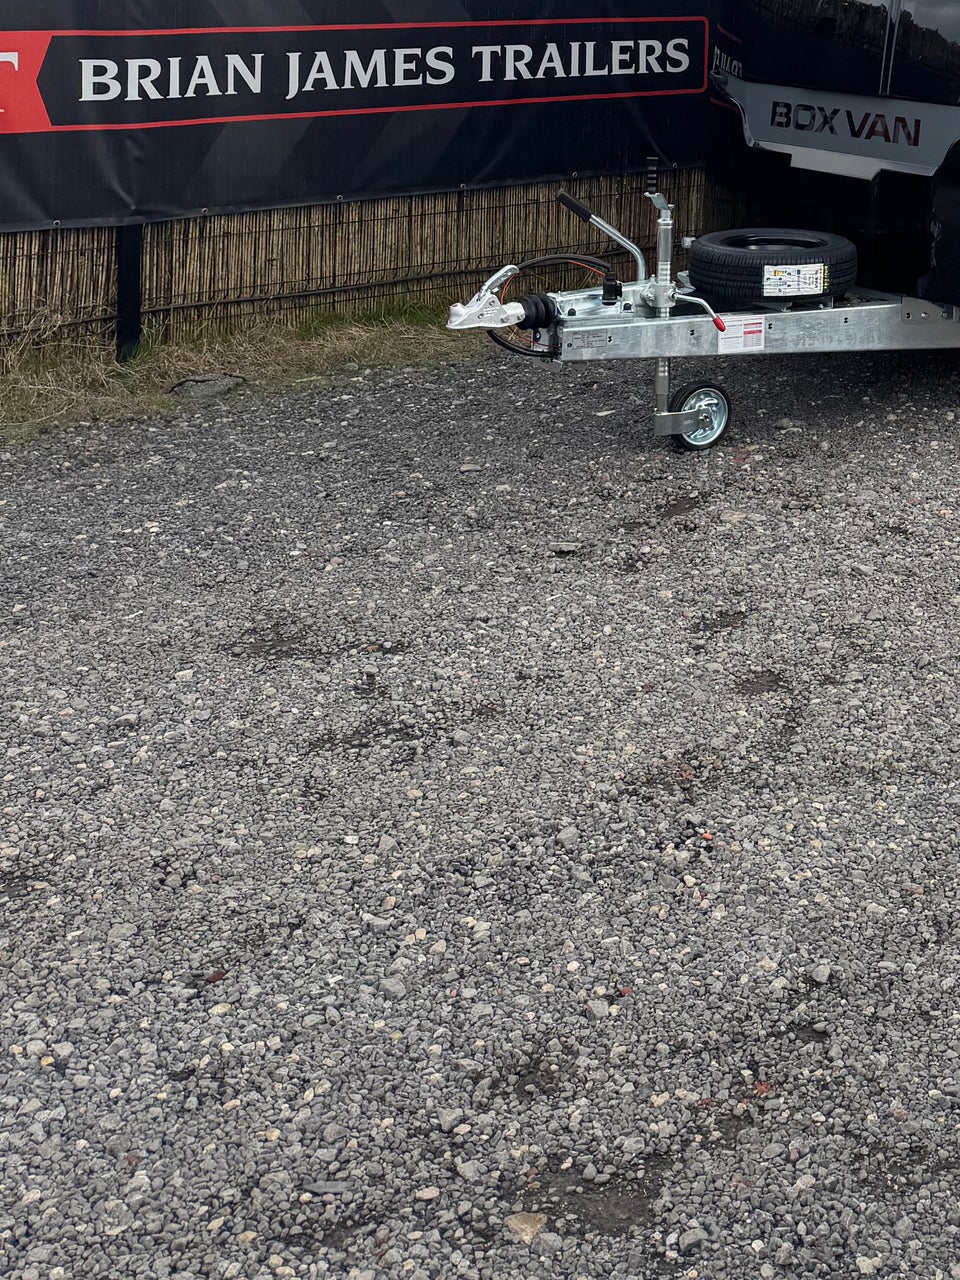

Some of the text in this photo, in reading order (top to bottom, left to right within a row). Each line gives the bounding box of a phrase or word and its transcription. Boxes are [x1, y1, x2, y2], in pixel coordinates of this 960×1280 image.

[78, 53, 265, 102] BRIAN
[285, 46, 456, 100] JAMES
[471, 38, 690, 82] TRAILERS
